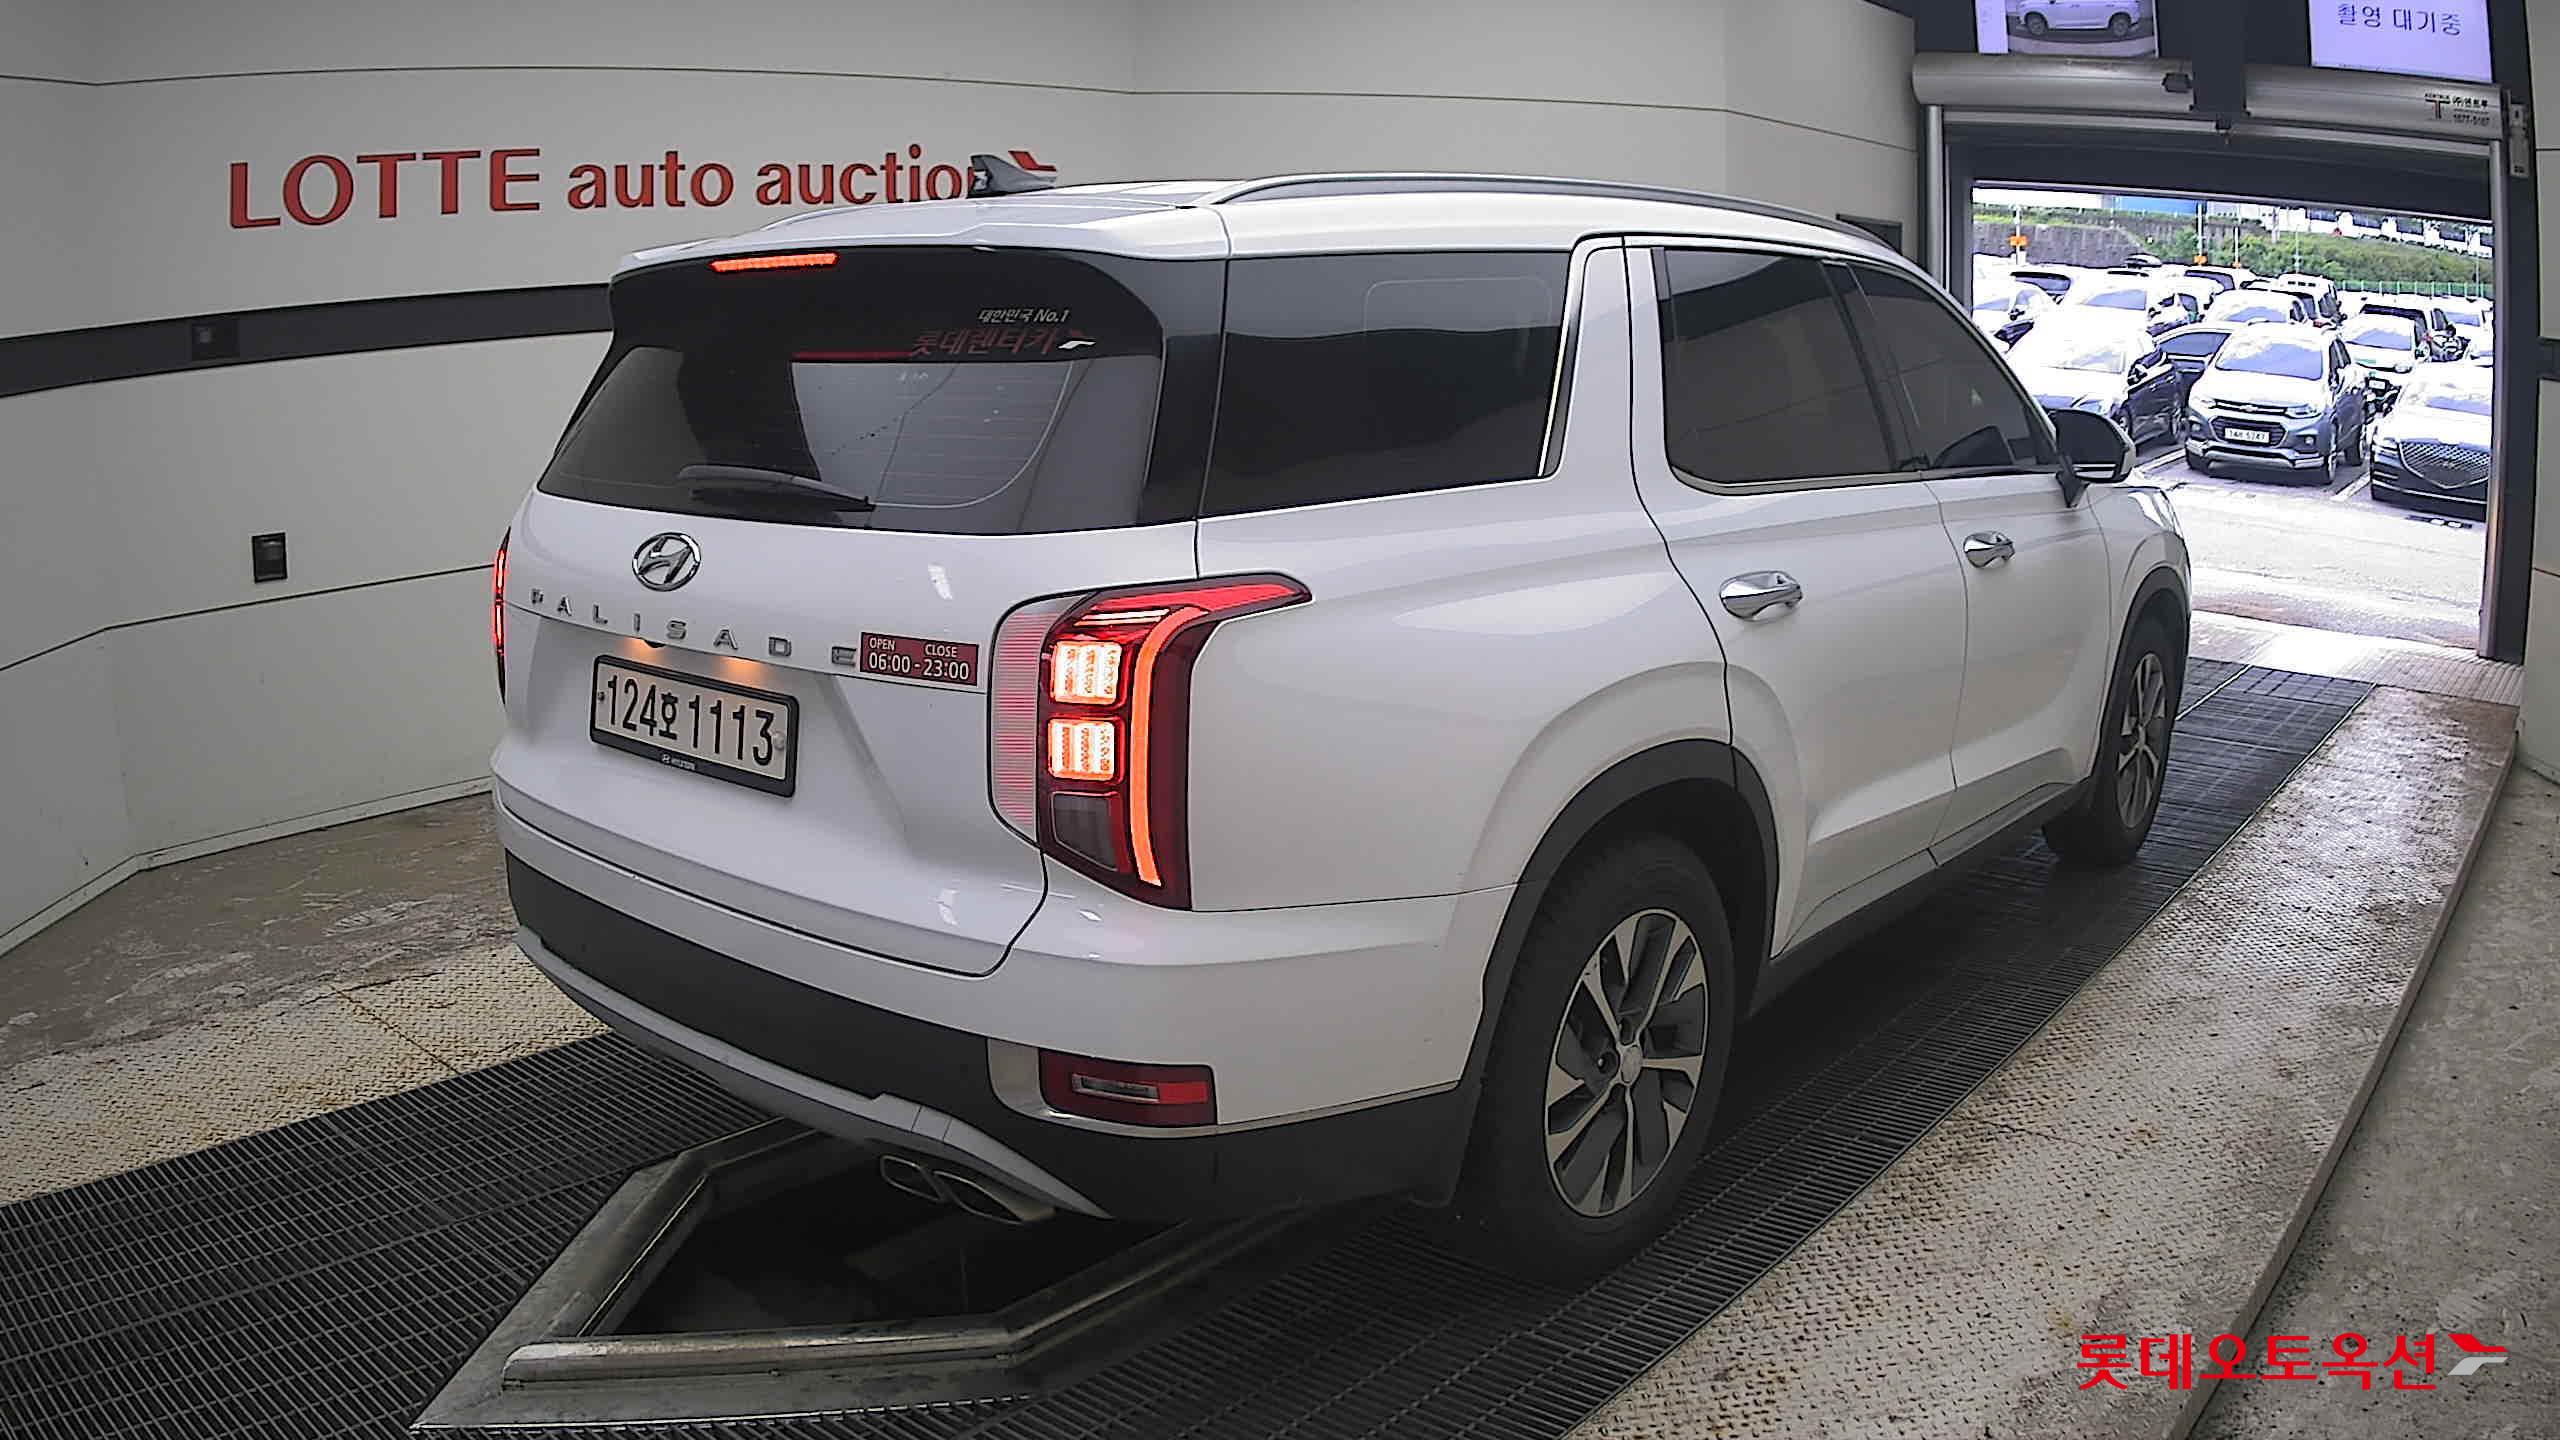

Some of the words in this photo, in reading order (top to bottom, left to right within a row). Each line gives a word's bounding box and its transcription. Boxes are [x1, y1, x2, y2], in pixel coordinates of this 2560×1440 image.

[2393, 8, 2462, 36] 대기중
[229, 148, 541, 228] LOTTE
[568, 150, 735, 209] auto
[756, 143, 975, 206] auctio
[978, 308, 1033, 323] 대한민국
[1033, 308, 1070, 322] No.1
[530, 588, 857, 667] PALISADE
[869, 637, 896, 651] OPEN
[925, 644, 958, 658] CLOSE
[869, 652, 911, 673] 06:00
[923, 658, 969, 680] 23:00
